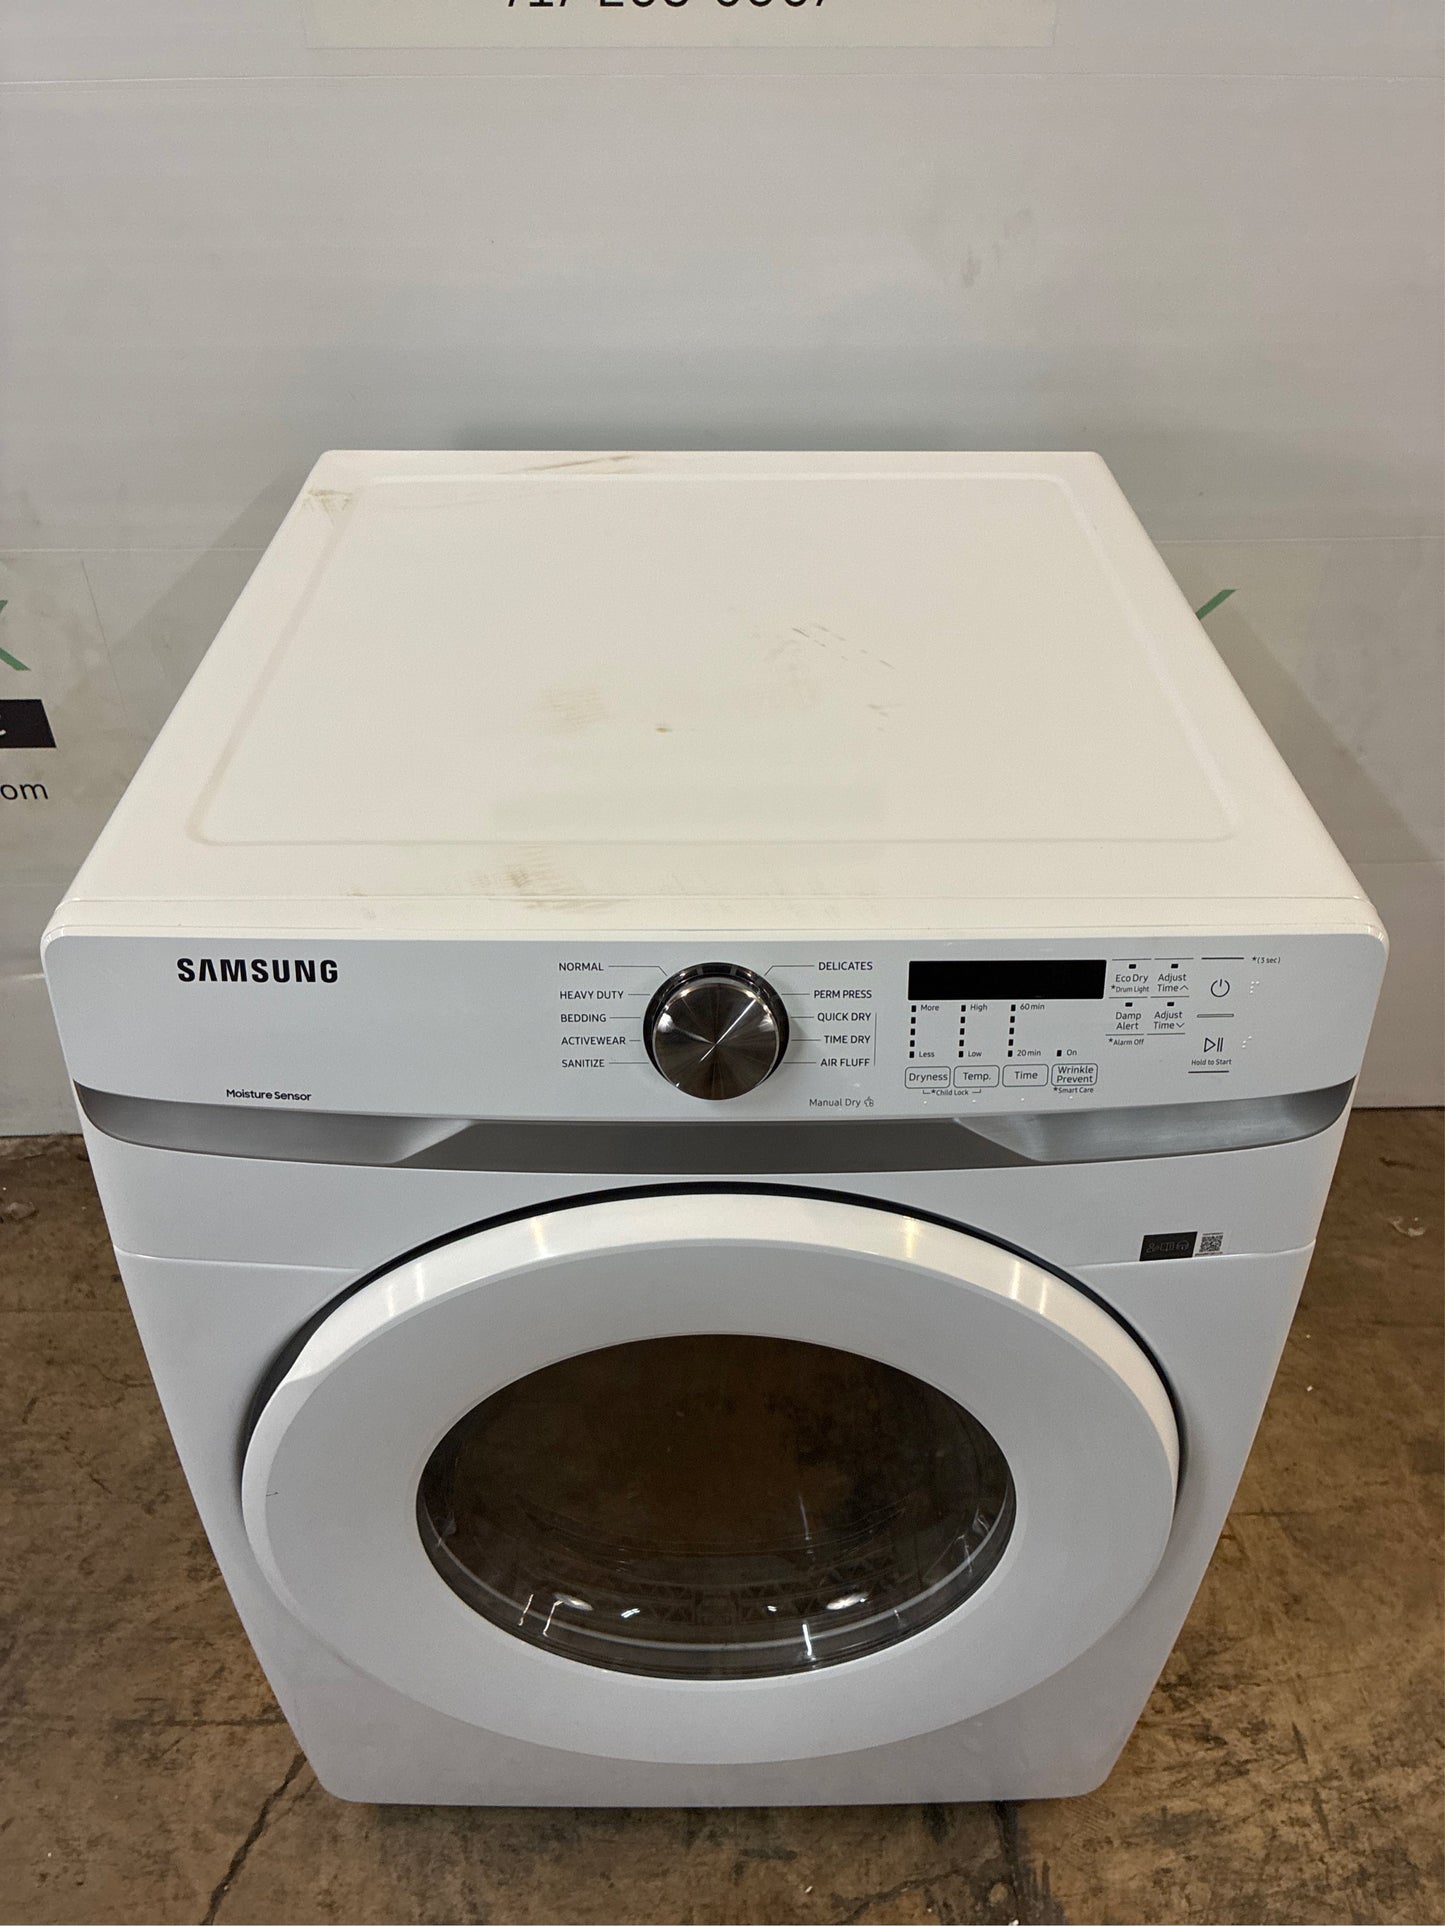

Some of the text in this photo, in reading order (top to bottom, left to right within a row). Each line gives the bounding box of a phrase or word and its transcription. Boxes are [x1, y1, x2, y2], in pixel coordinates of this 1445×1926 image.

[177, 958, 338, 983] SAMSUNG
[559, 962, 604, 972] NORMAL
[818, 961, 873, 971] DELICATES
[1115, 973, 1149, 985] Eco Dry
[1157, 972, 1187, 984] Adjust
[1133, 984, 1150, 994] Light
[1157, 983, 1179, 993] Time
[559, 990, 624, 1000] HEAVY DUTY
[813, 989, 872, 999] PERM PRESS
[920, 1003, 940, 1012] More
[969, 1003, 988, 1013] High
[1019, 1002, 1045, 1011] 60 min
[560, 1013, 607, 1023] BEDDING
[817, 1012, 871, 1023] QUICK DRY
[1115, 1011, 1142, 1021] Damp
[1154, 1010, 1183, 1021] Adjust
[1116, 1022, 1139, 1031] Alert
[1153, 1021, 1175, 1031] Time
[561, 1035, 626, 1046] ACTIVEWEAR
[823, 1034, 871, 1044] TIME DRY
[1133, 1037, 1145, 1047] Off
[918, 1050, 935, 1059] Less
[967, 1050, 982, 1059] Low
[1016, 1049, 1042, 1058] 20 min
[1066, 1048, 1078, 1057] On
[561, 1058, 605, 1068] SANITIZE
[819, 1057, 870, 1067] AIR FLUFF
[1190, 1058, 1232, 1067] Hold to Start
[1056, 1065, 1095, 1075] Wrinkle
[908, 1072, 949, 1083] Dryness
[962, 1071, 992, 1083] Temp.
[1014, 1070, 1039, 1081] Time
[1056, 1074, 1094, 1084] Prevent
[954, 1089, 969, 1097] Lock
[1079, 1085, 1095, 1094] Care
[225, 1088, 312, 1102] Moisture Sensor
[808, 1097, 861, 1109] Manual Dry
